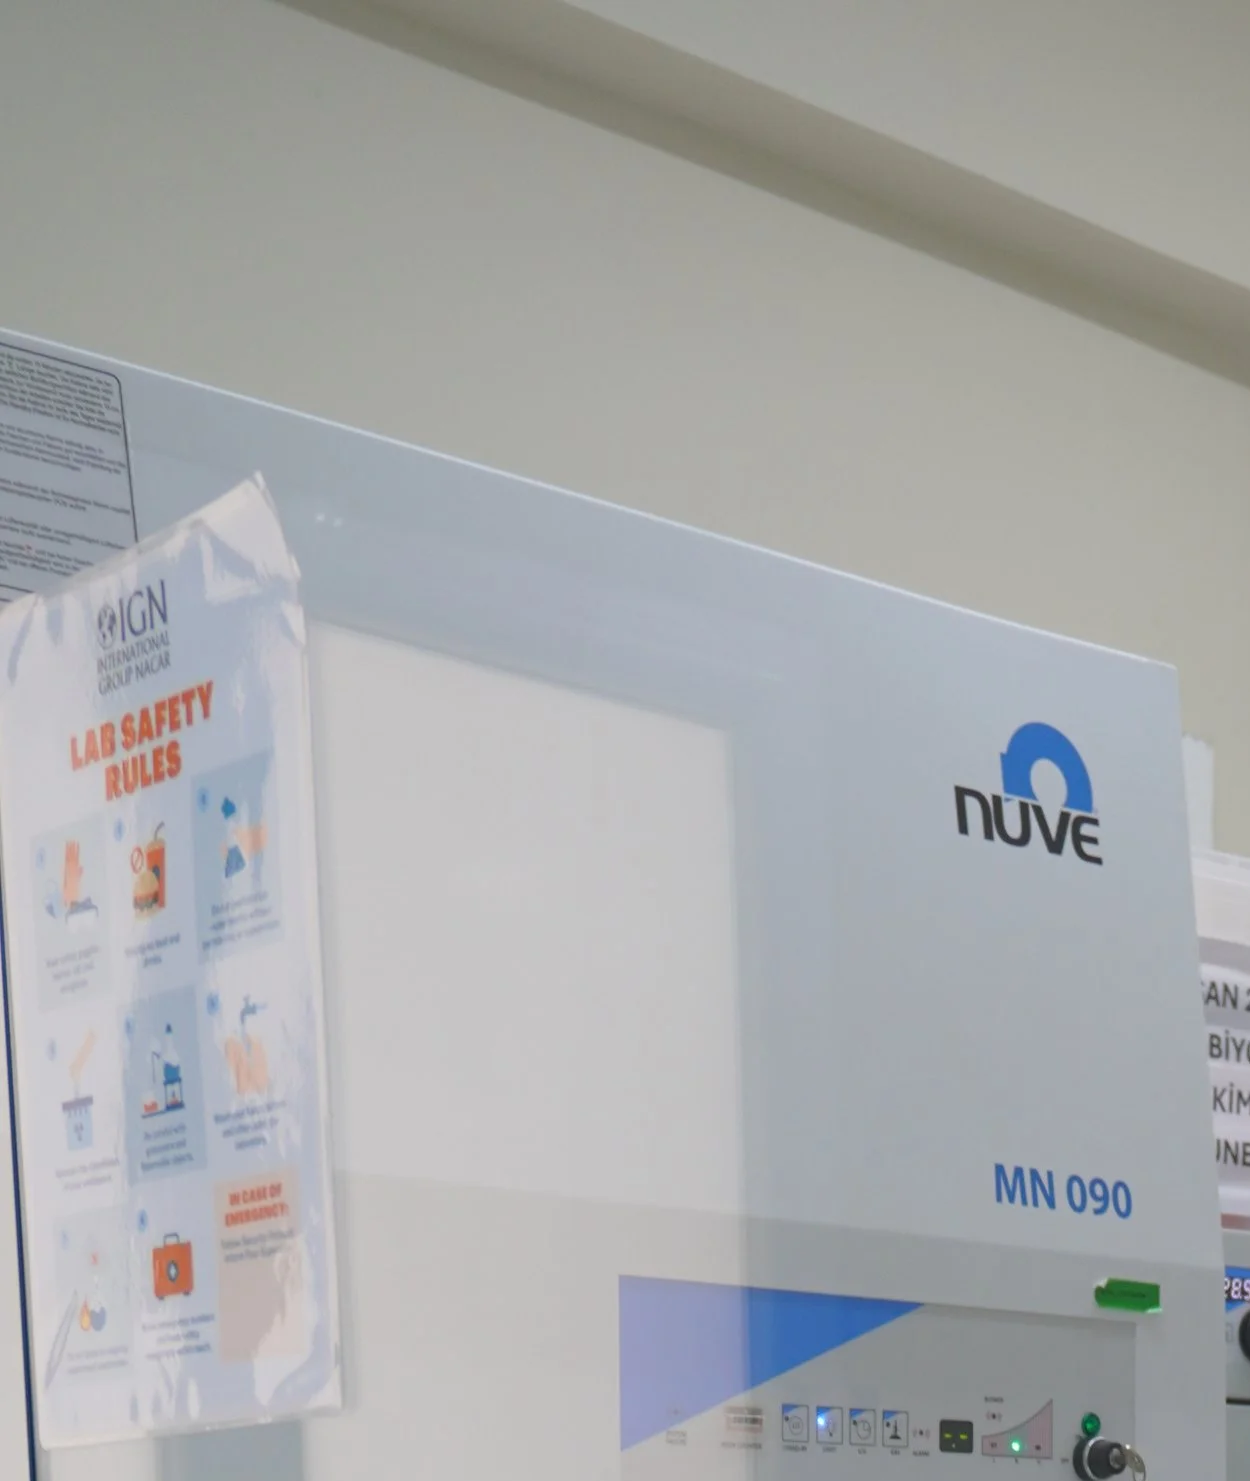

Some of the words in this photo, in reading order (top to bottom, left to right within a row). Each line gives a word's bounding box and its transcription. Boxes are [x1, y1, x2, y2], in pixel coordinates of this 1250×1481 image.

[118, 578, 169, 643] IGN
[96, 629, 171, 674] INTERNATIONAL
[98, 664, 134, 697] GROUP
[70, 719, 116, 771] LAB
[120, 679, 214, 753] SAFETY
[105, 739, 182, 802] RULES
[1202, 979, 1239, 1011] AN
[995, 1164, 1056, 1211] MN
[1066, 1174, 1133, 1220] 090
